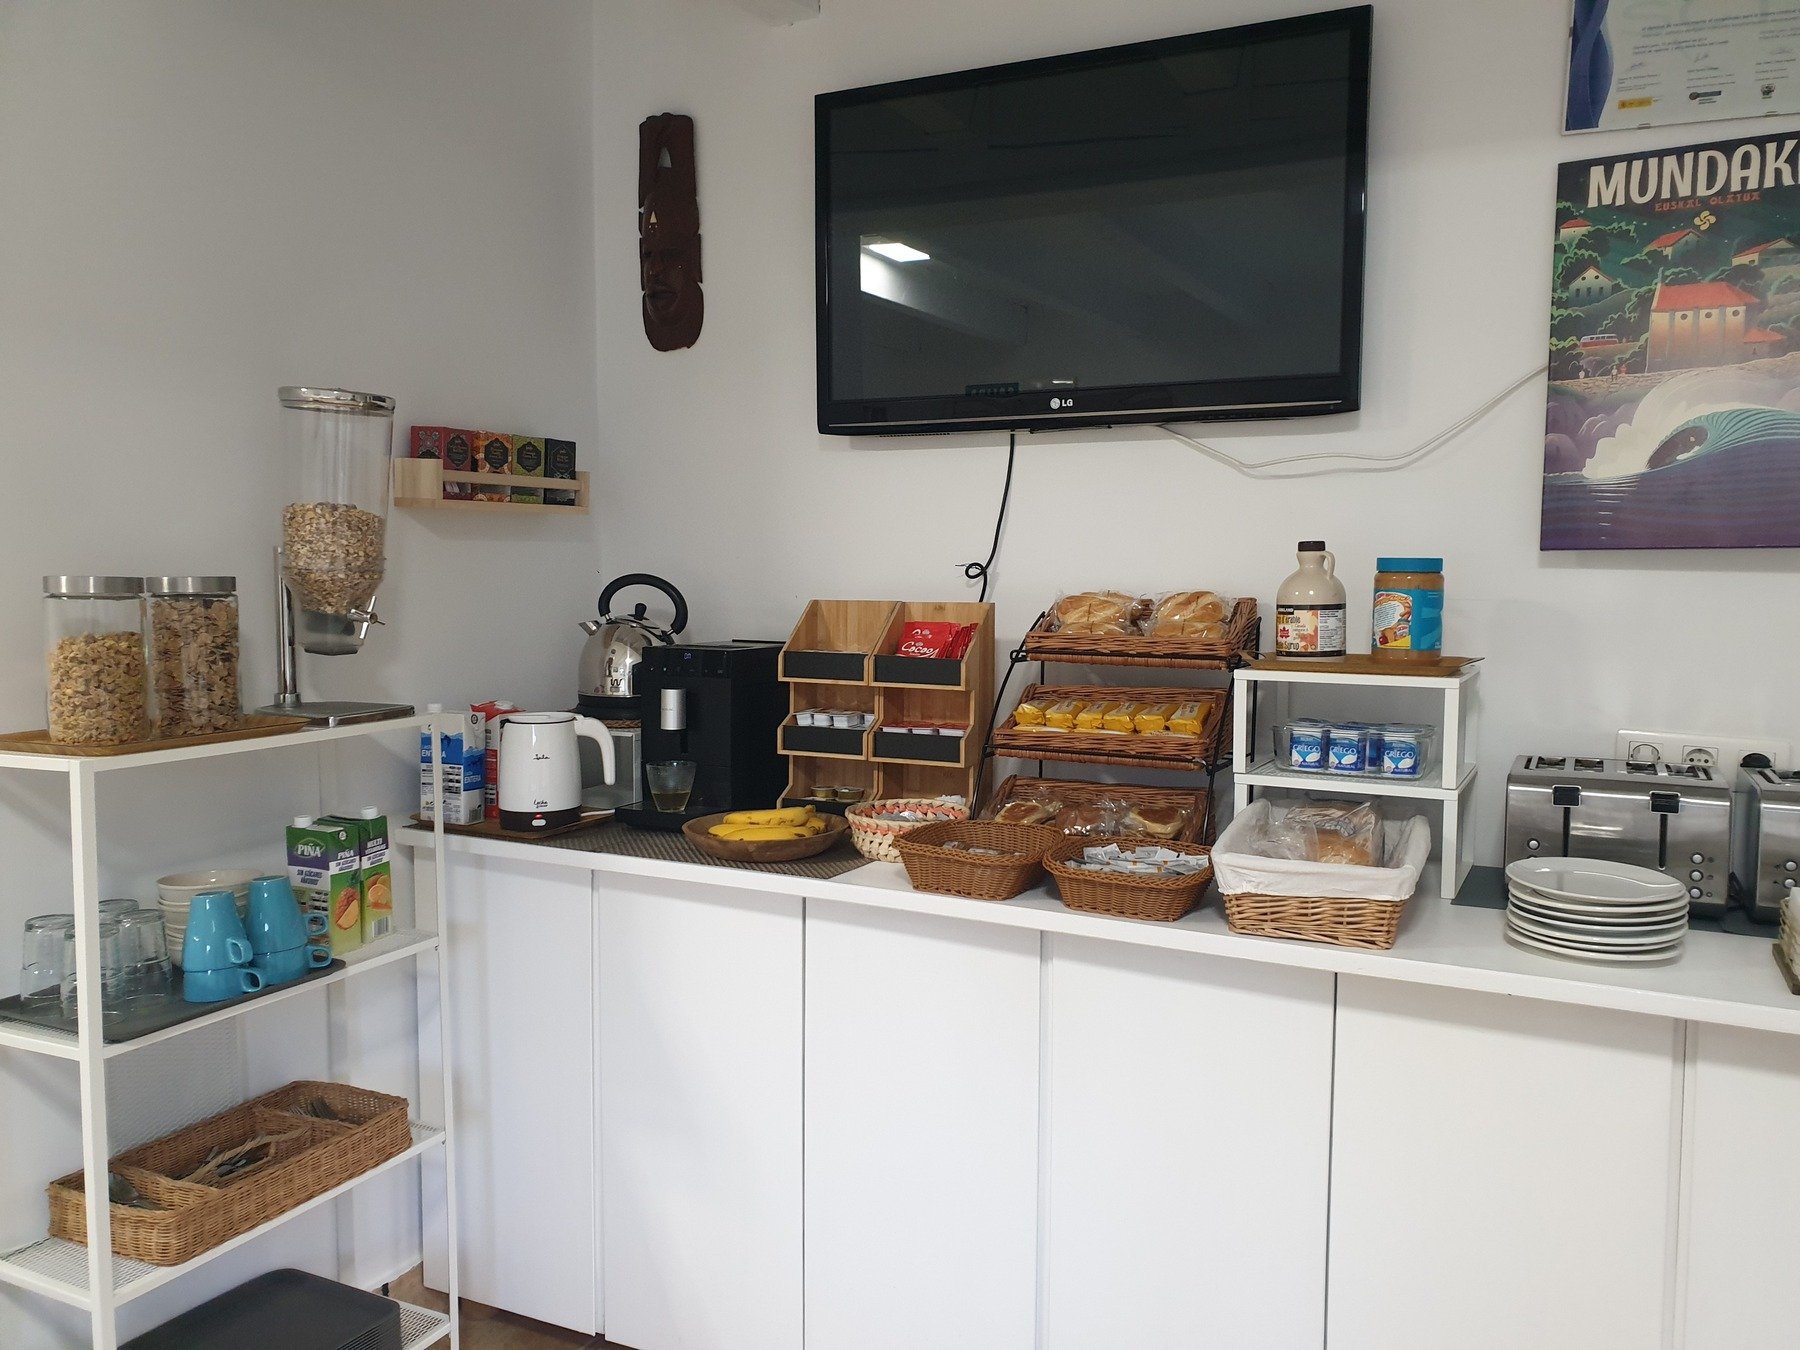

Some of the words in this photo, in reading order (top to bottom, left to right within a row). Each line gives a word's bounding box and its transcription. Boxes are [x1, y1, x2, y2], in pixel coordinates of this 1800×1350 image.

[1587, 138, 1800, 209] MUNDAK
[1655, 198, 1702, 212] EUSKAL
[1062, 399, 1073, 407] LG
[1292, 743, 1321, 753] GRIEGO
[1329, 744, 1357, 755] GRIEGO
[1384, 750, 1414, 759] GRIEGO
[297, 843, 321, 858] PIÑA
[337, 848, 355, 860] PIÑA
